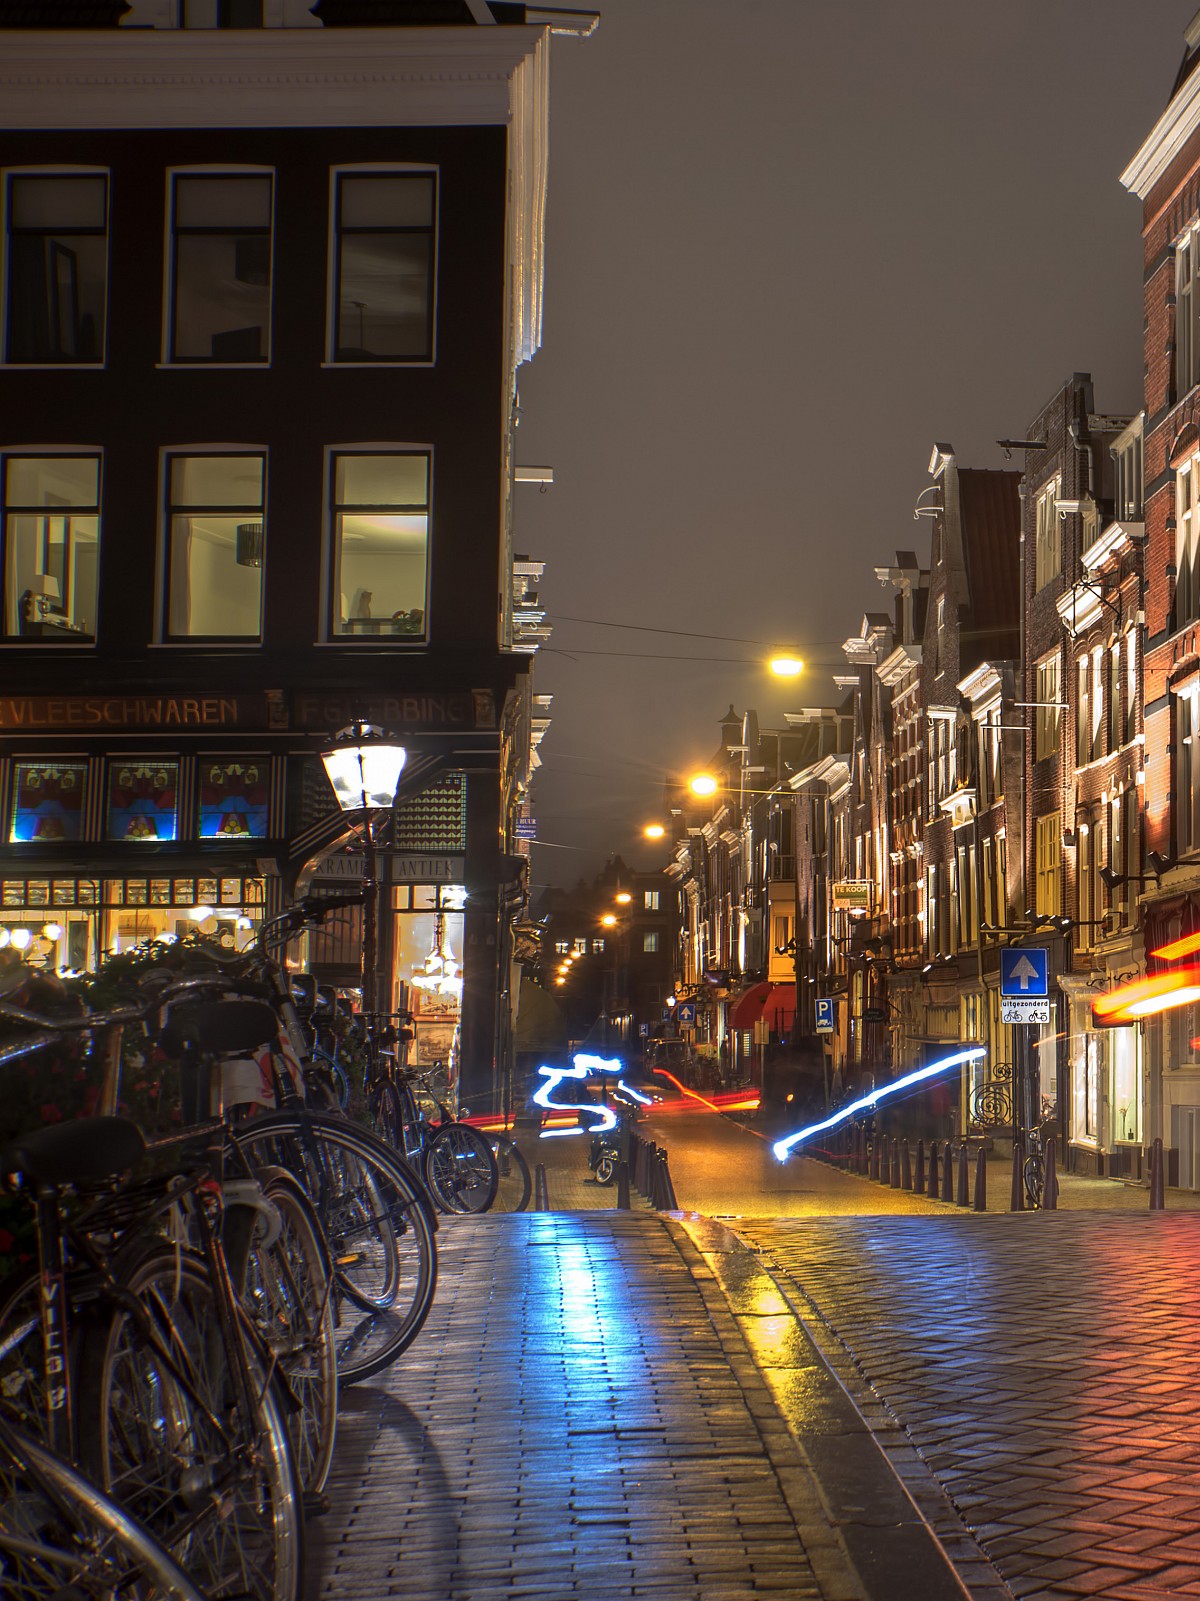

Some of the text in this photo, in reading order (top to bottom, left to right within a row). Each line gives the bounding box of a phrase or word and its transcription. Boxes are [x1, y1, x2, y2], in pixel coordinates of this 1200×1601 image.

[9, 699, 239, 724] VLEESCHWAREN
[399, 859, 456, 876] ANTIEK
[818, 1001, 829, 1017] P
